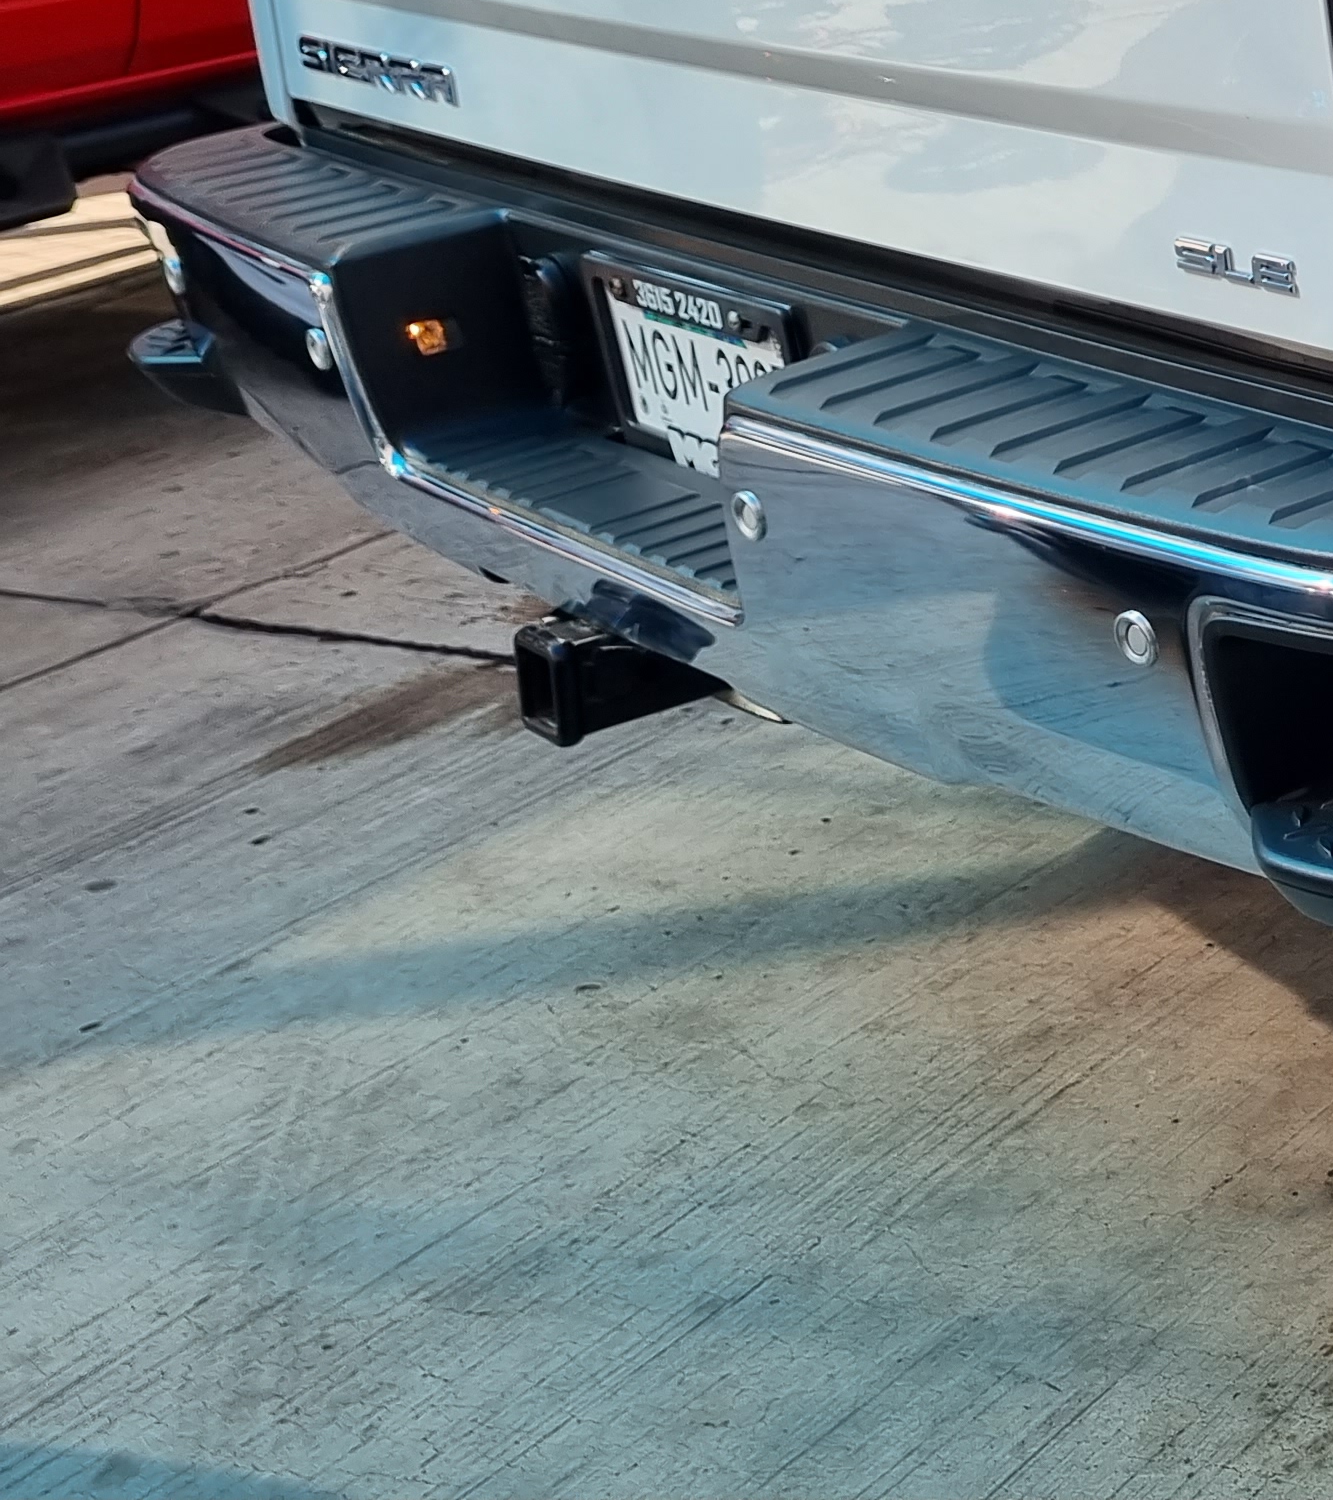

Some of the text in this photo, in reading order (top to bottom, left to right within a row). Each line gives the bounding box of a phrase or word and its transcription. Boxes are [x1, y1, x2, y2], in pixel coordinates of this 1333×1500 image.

[298, 34, 461, 108] SIERRA
[1174, 236, 1300, 298] SLE
[674, 290, 724, 330] 2420
